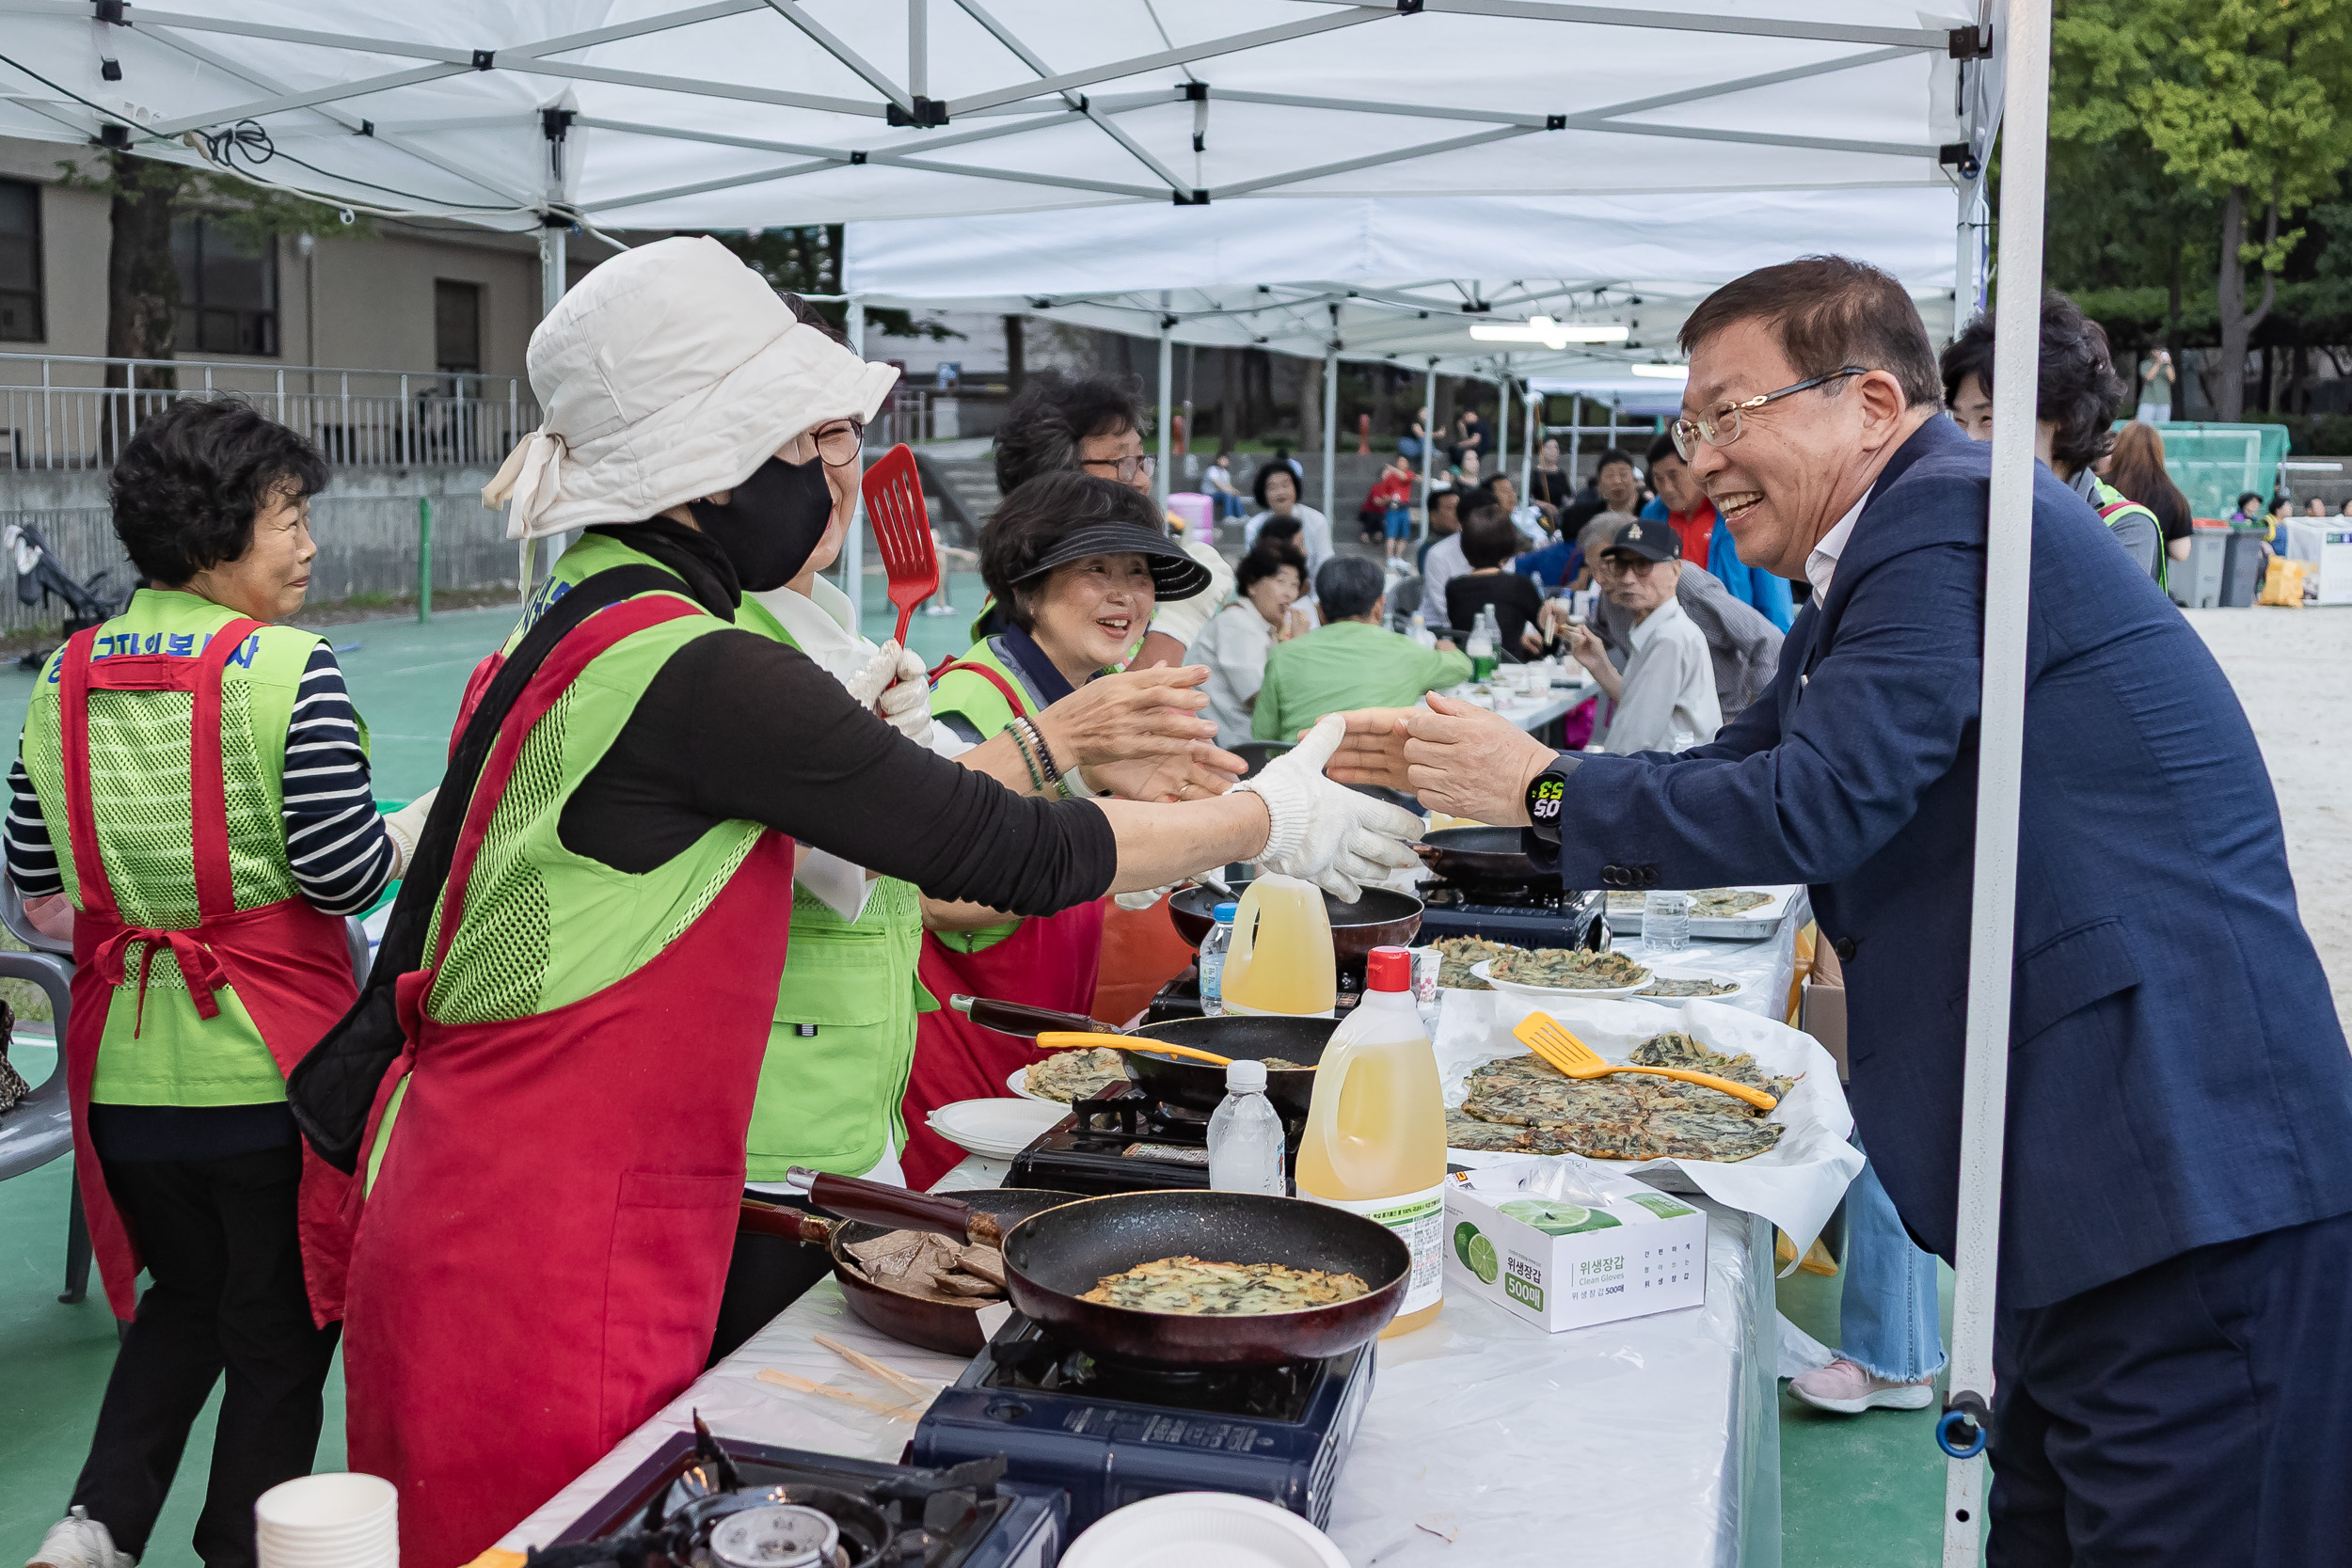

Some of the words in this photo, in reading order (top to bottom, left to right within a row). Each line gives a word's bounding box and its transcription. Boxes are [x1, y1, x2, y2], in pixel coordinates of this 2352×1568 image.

[1507, 1257, 1542, 1284] 위생장갑
[1580, 1255, 1625, 1275] 위생장갑
[1579, 1275, 1600, 1286] Clean
[1600, 1273, 1625, 1283] Gloves
[1605, 1284, 1625, 1295] 500매
[1508, 1277, 1541, 1308] 500매
